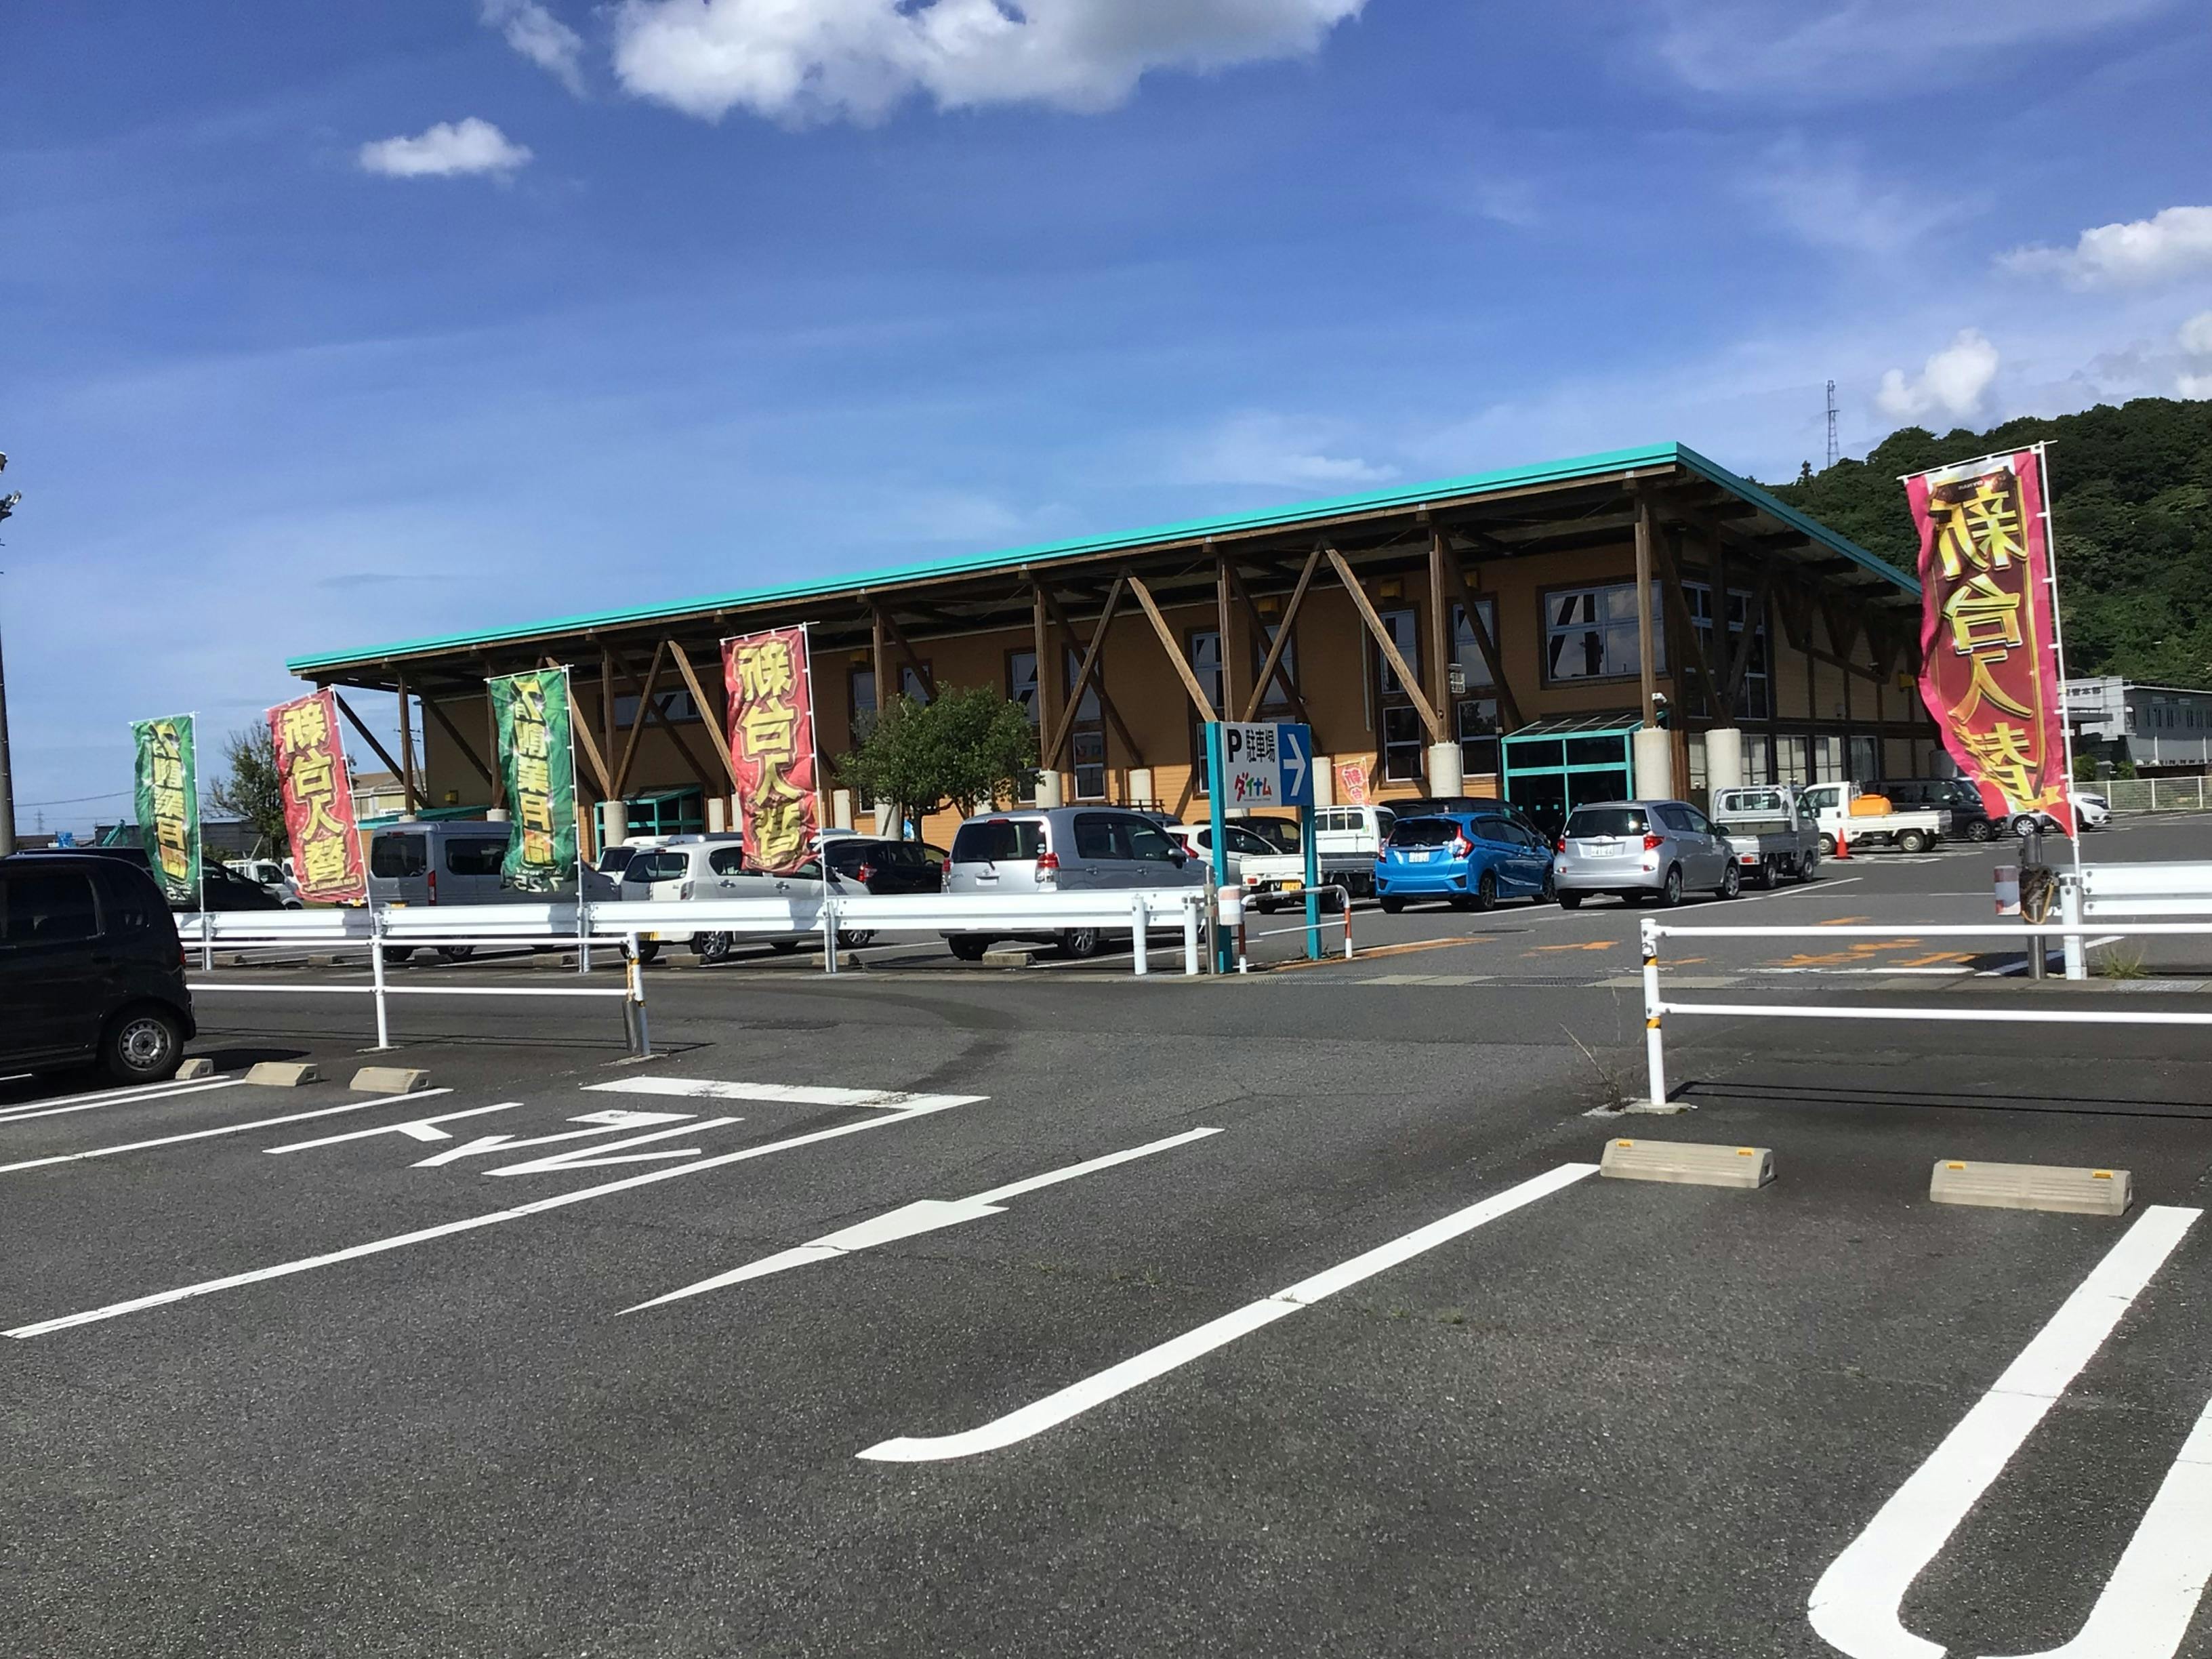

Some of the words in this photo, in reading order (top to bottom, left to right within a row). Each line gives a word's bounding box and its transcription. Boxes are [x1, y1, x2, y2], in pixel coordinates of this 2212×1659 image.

[1227, 729, 1242, 763] P
[1246, 729, 1275, 763] 駐車場
[1234, 772, 1273, 802] ダイナム
